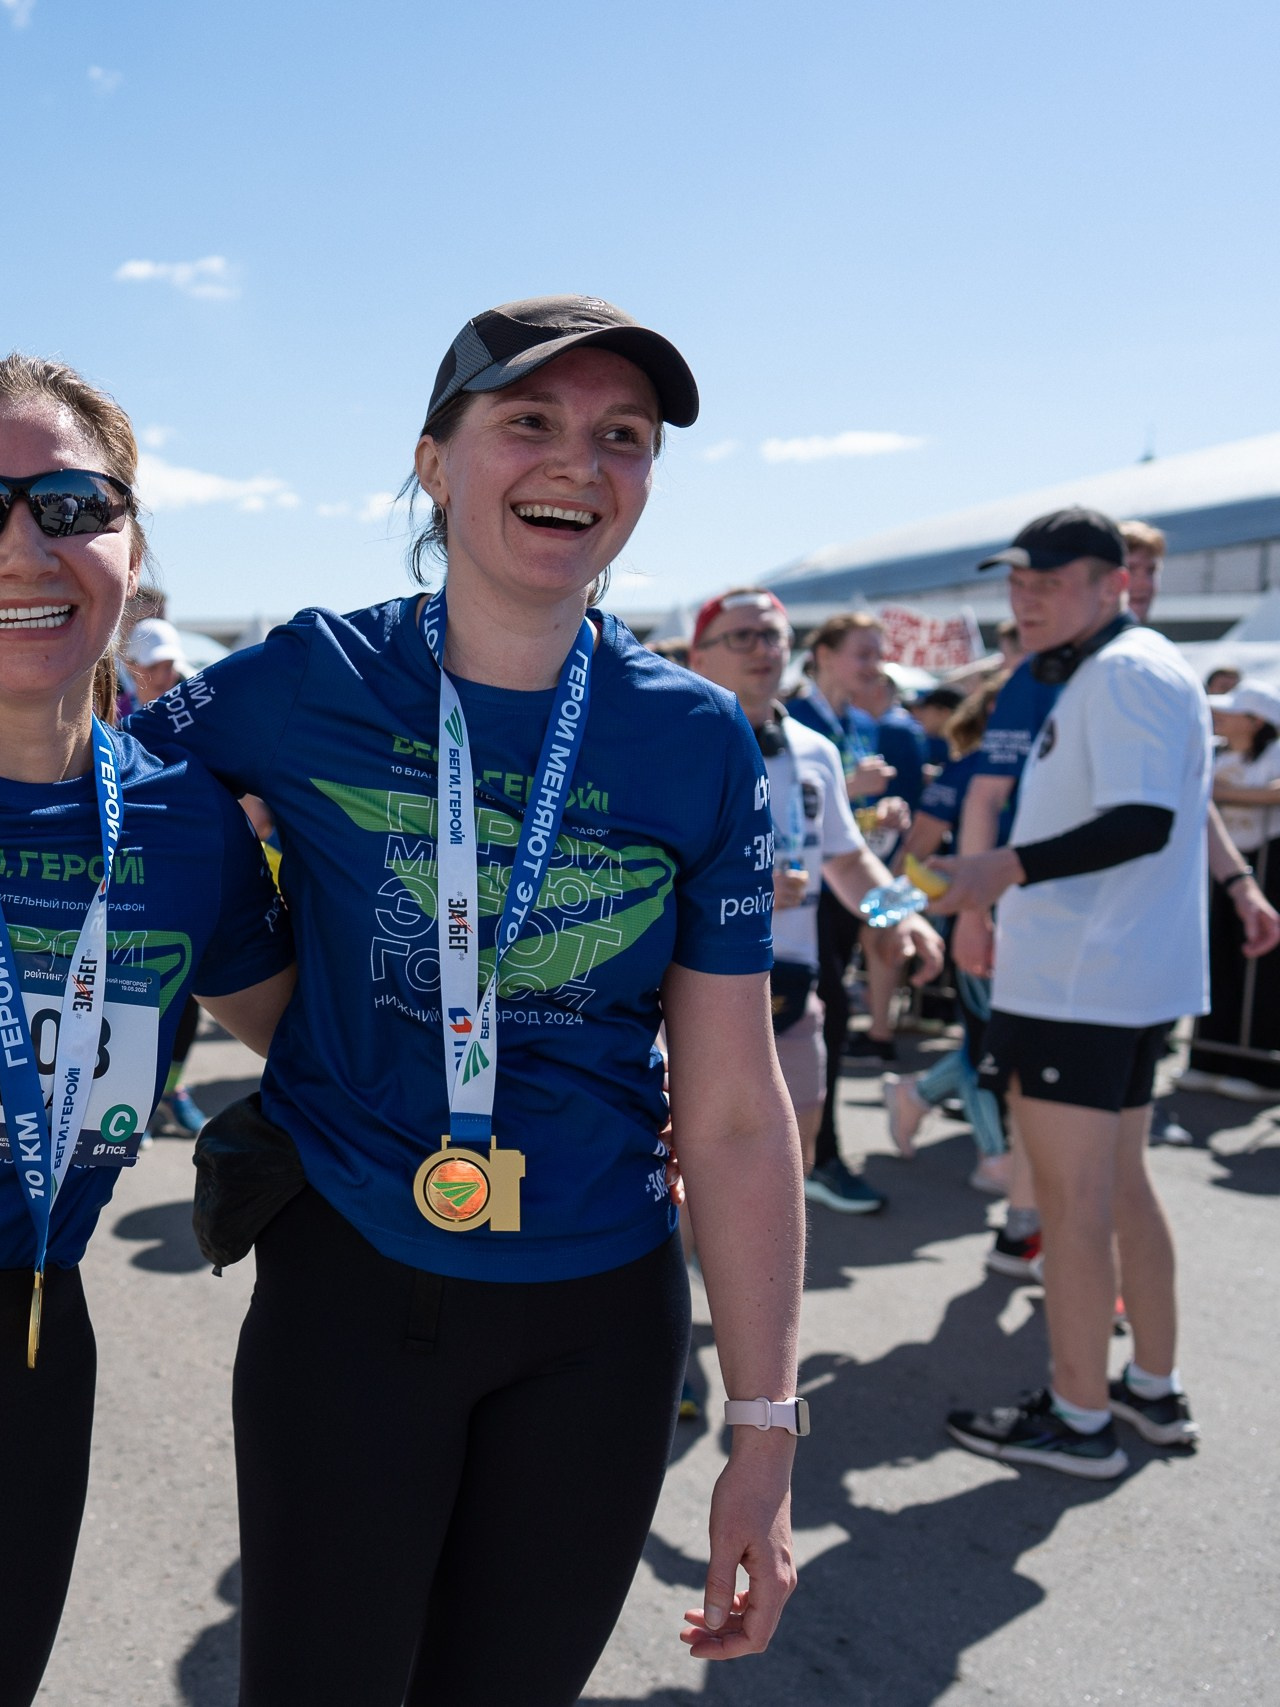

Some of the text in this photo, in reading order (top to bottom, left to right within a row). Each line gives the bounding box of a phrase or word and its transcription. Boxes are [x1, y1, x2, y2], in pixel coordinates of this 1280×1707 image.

[555, 649, 590, 742] ГЕРОИ
[99, 745, 120, 842] ГЕРОИ
[450, 790, 466, 845] ГЕРОЙ!
[524, 743, 571, 879] МЕНЯЮТ
[544, 1011, 584, 1025] 2024
[106, 1145, 127, 1155] ПСБ
[27, 1169, 45, 1199] 10
